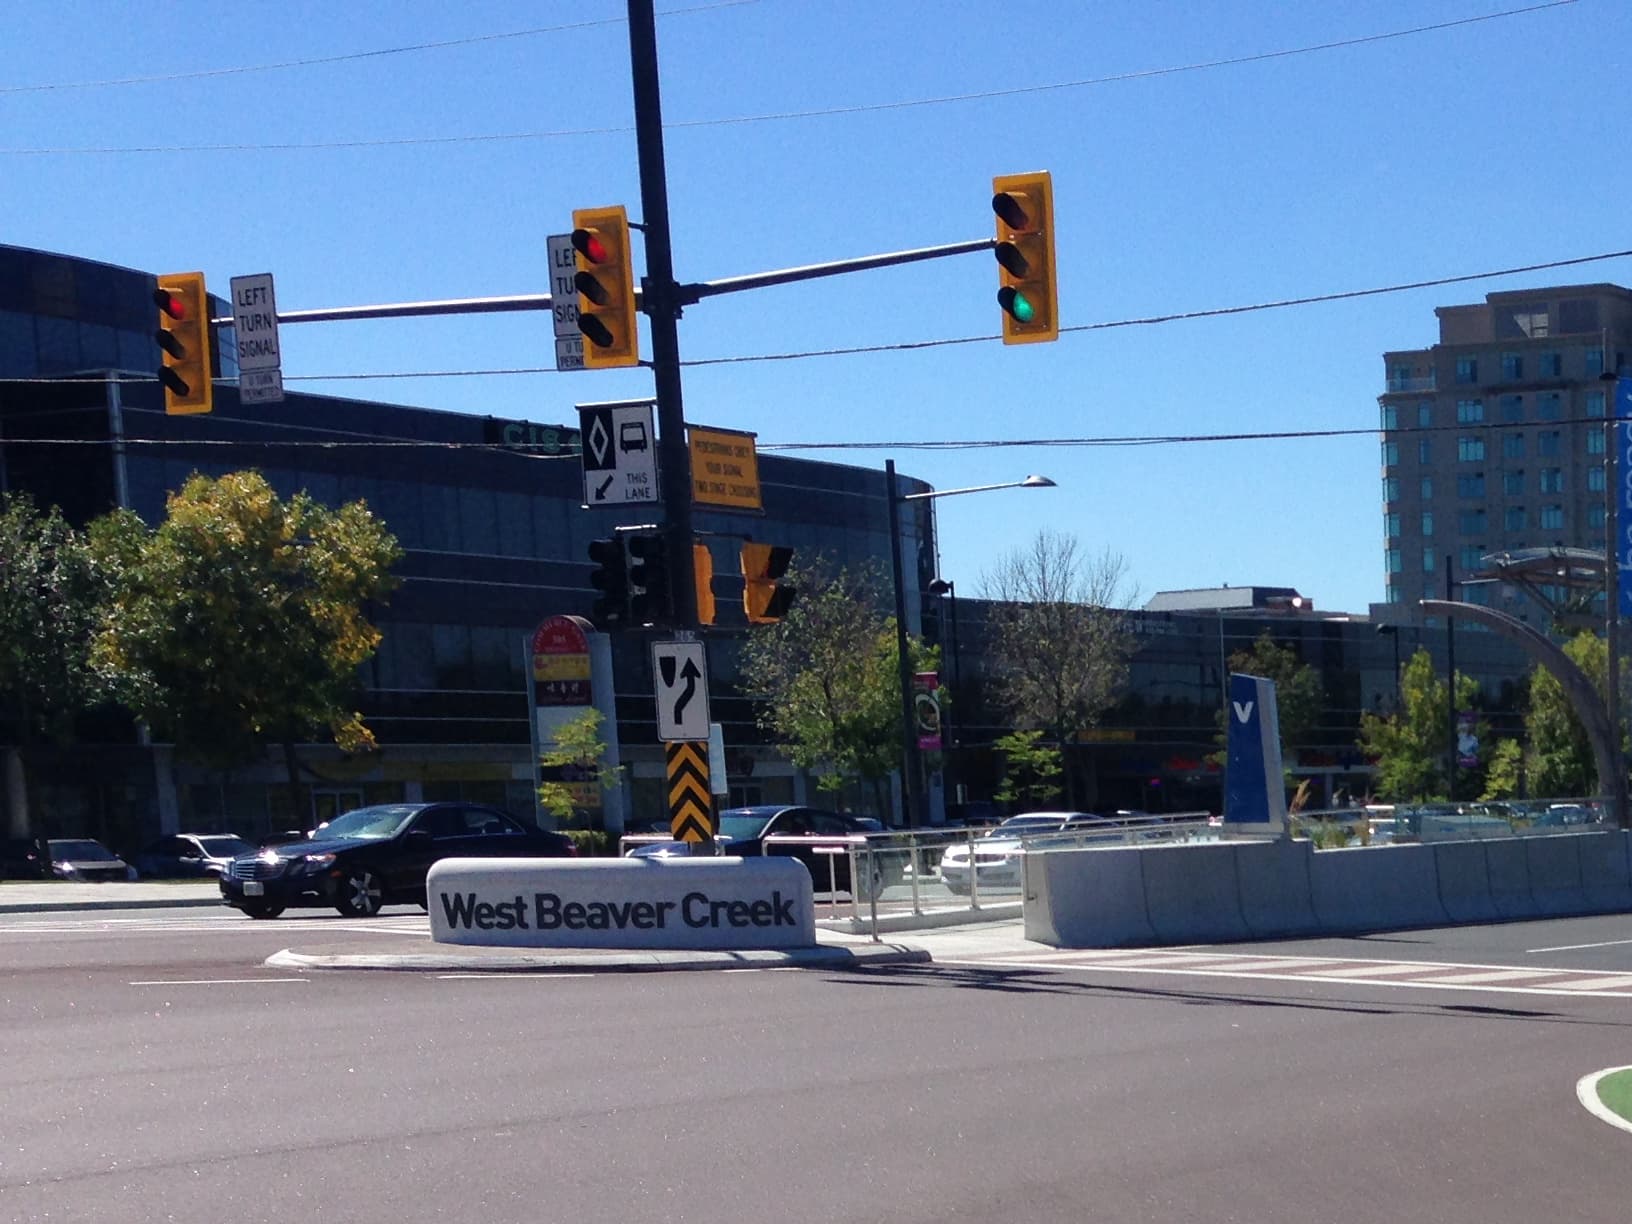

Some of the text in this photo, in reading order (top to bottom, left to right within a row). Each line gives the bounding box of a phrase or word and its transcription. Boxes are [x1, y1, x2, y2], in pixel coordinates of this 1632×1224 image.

[555, 248, 577, 268] LEF
[557, 277, 578, 295] TU
[238, 287, 266, 307] LEFT
[239, 313, 272, 332] TURN
[556, 305, 581, 322] SIGN
[239, 340, 276, 358] SIGNAL
[626, 473, 648, 485] THIS
[625, 487, 650, 500] LANE
[439, 890, 797, 931] West Beaver Creek
